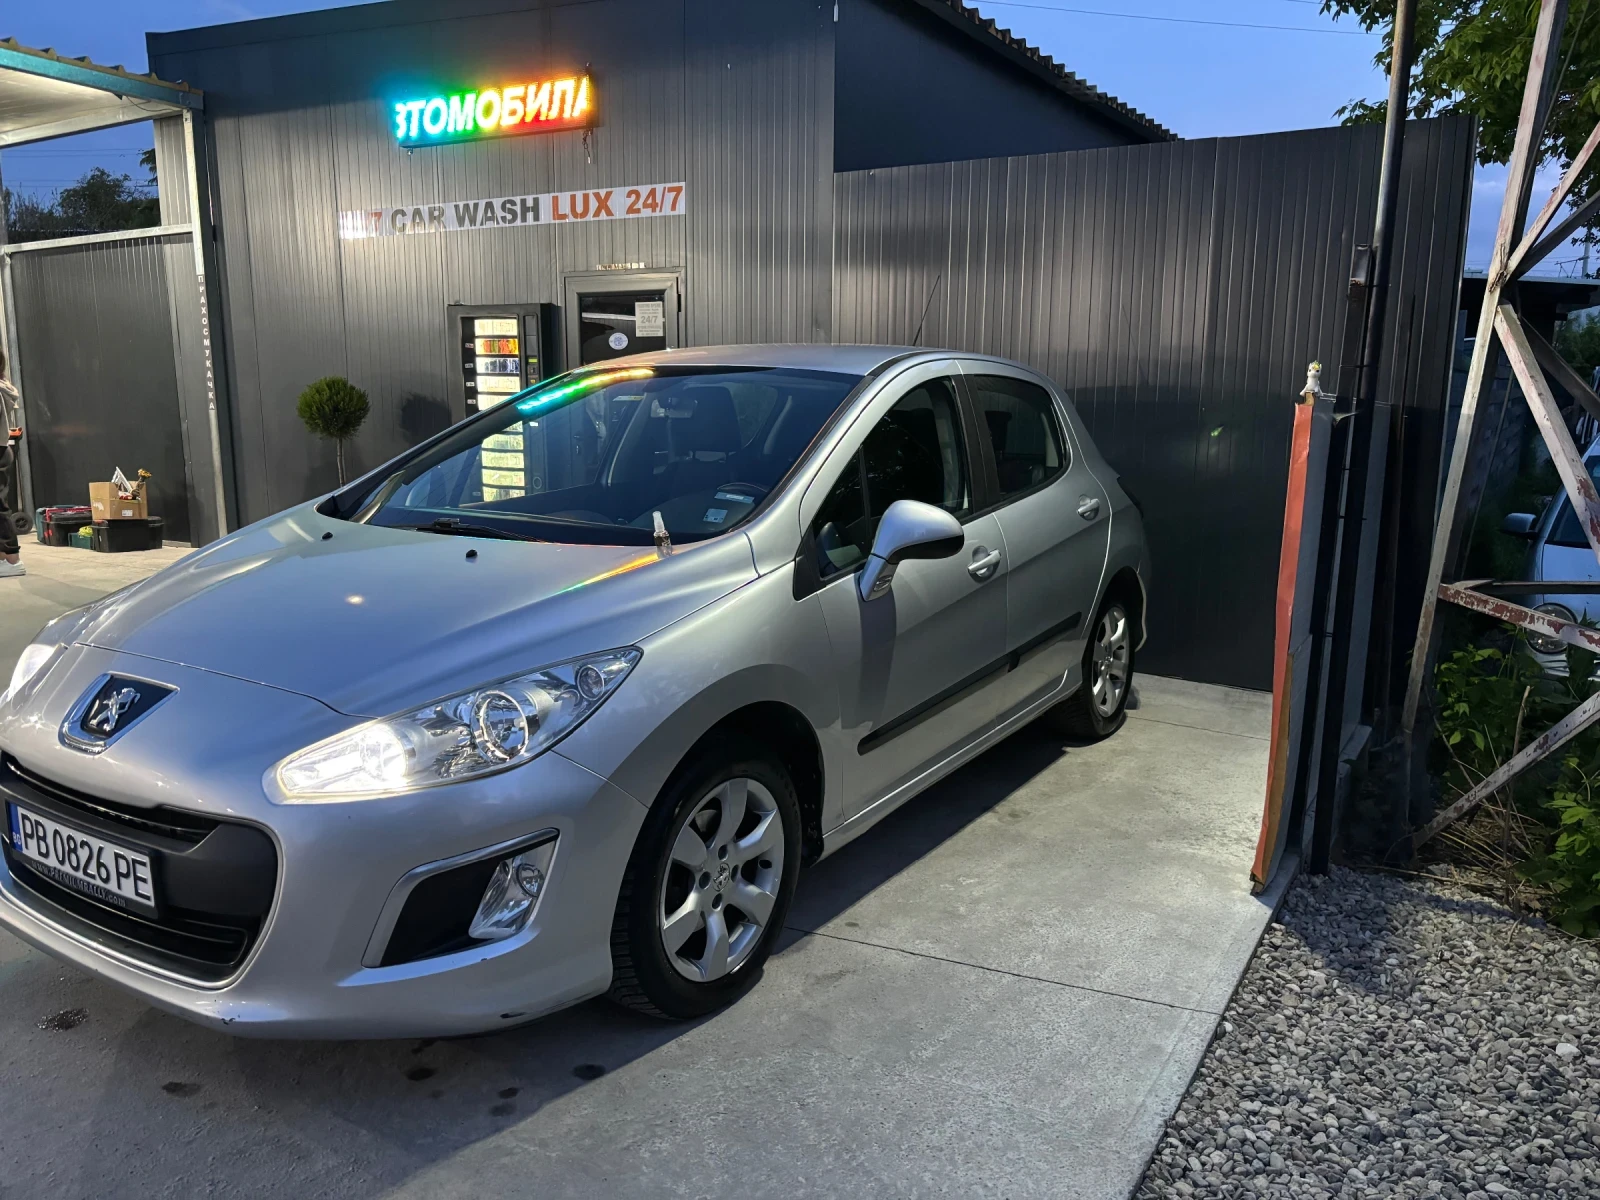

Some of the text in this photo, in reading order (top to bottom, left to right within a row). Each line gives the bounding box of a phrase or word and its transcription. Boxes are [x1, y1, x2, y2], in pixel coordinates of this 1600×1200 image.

[391, 206, 446, 233] CAR
[453, 196, 540, 228] WASH
[551, 190, 614, 221] LUX
[625, 185, 684, 215] 24/7
[640, 315, 658, 325] 24/7
[52, 828, 111, 885] 0826
